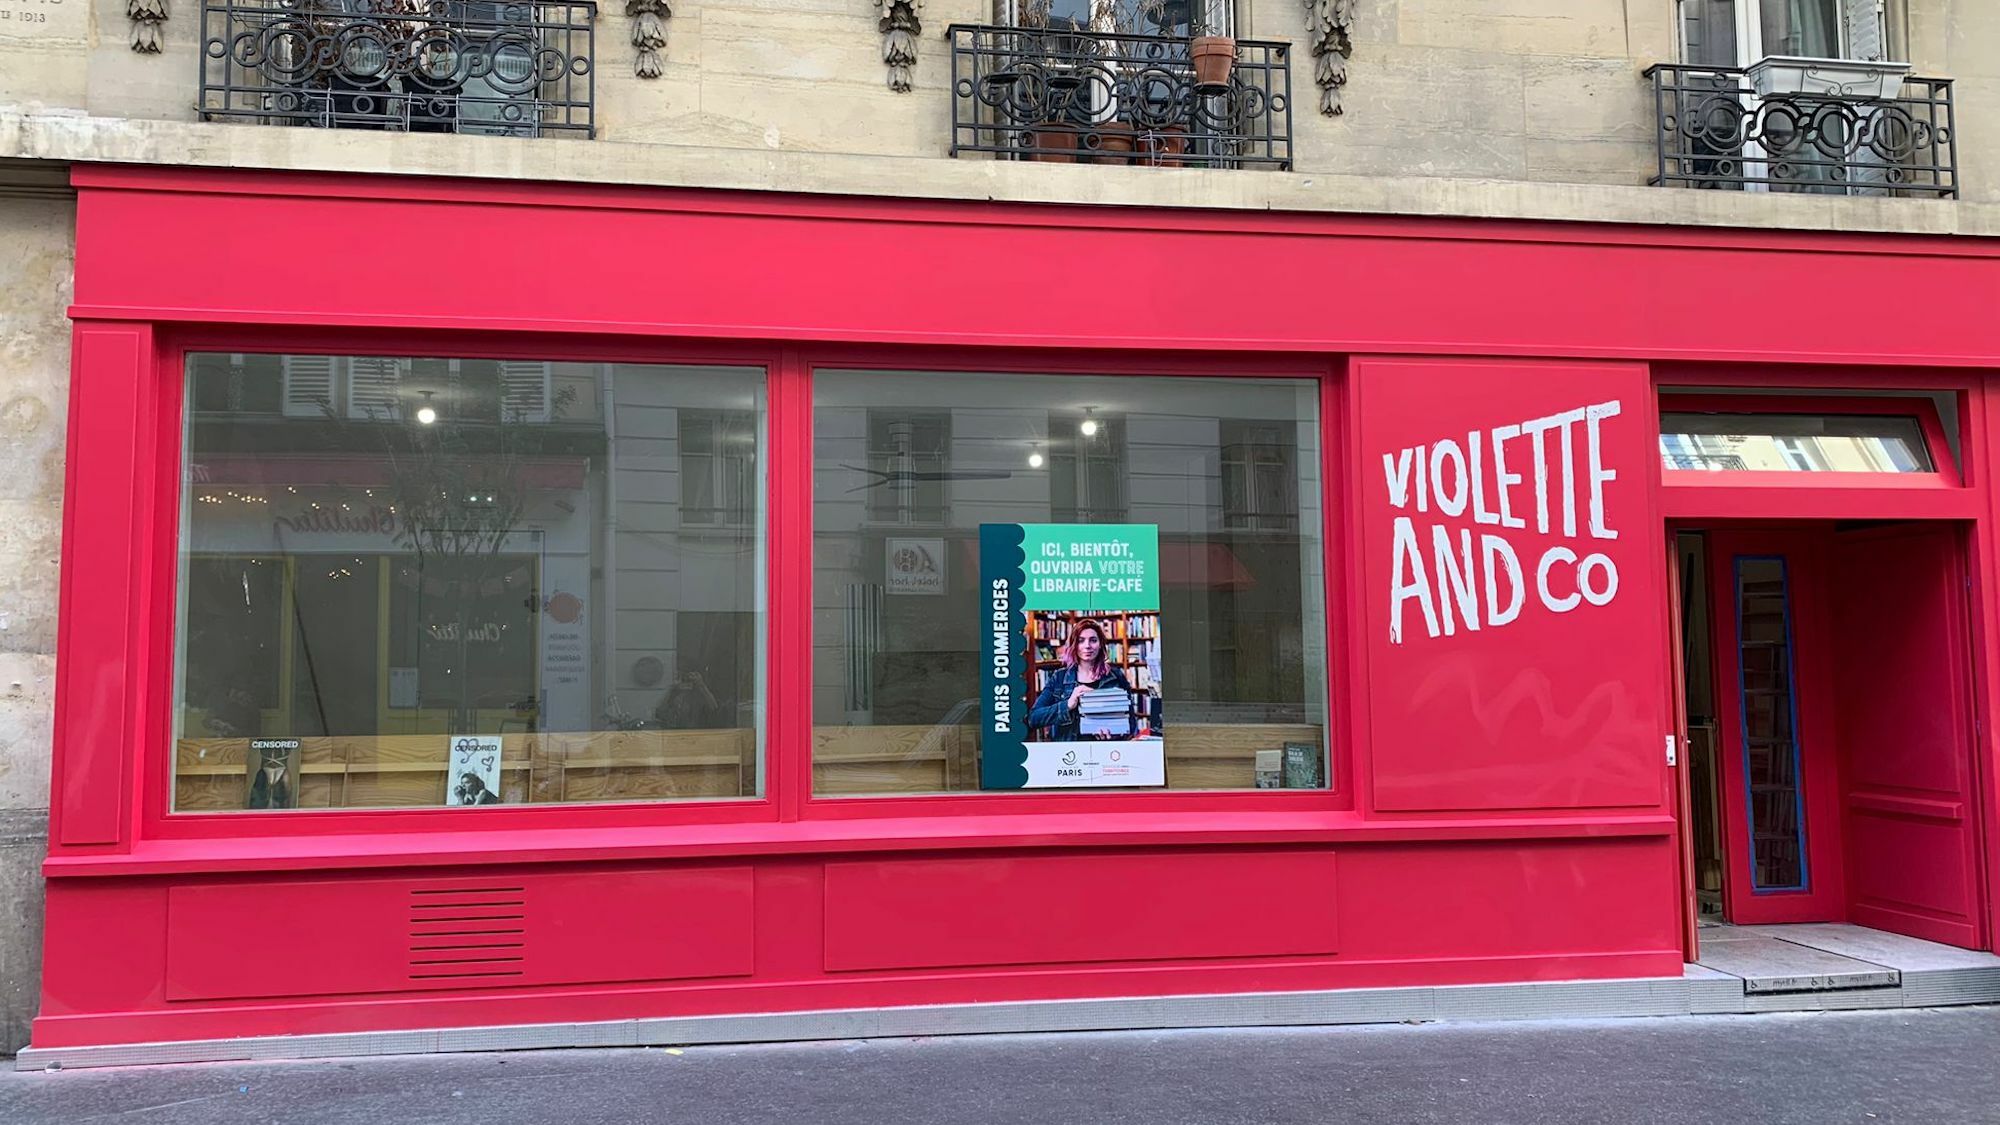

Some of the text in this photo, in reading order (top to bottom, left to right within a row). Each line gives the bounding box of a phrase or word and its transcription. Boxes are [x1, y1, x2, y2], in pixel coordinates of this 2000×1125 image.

[19, 12, 46, 23] 1913
[1383, 400, 1621, 539] VIOLETTE
[1041, 539, 1134, 558] ICI, BIENTÔT,
[1031, 560, 1145, 575] OUVRIRA VOTRE
[1033, 575, 1143, 592] LIBRAIRIE-CAFÉ
[1389, 517, 1619, 644] AND CO
[992, 578, 1010, 679] COMMERCES
[252, 741, 298, 749] CENSORED
[1058, 769, 1082, 777] PARIS
